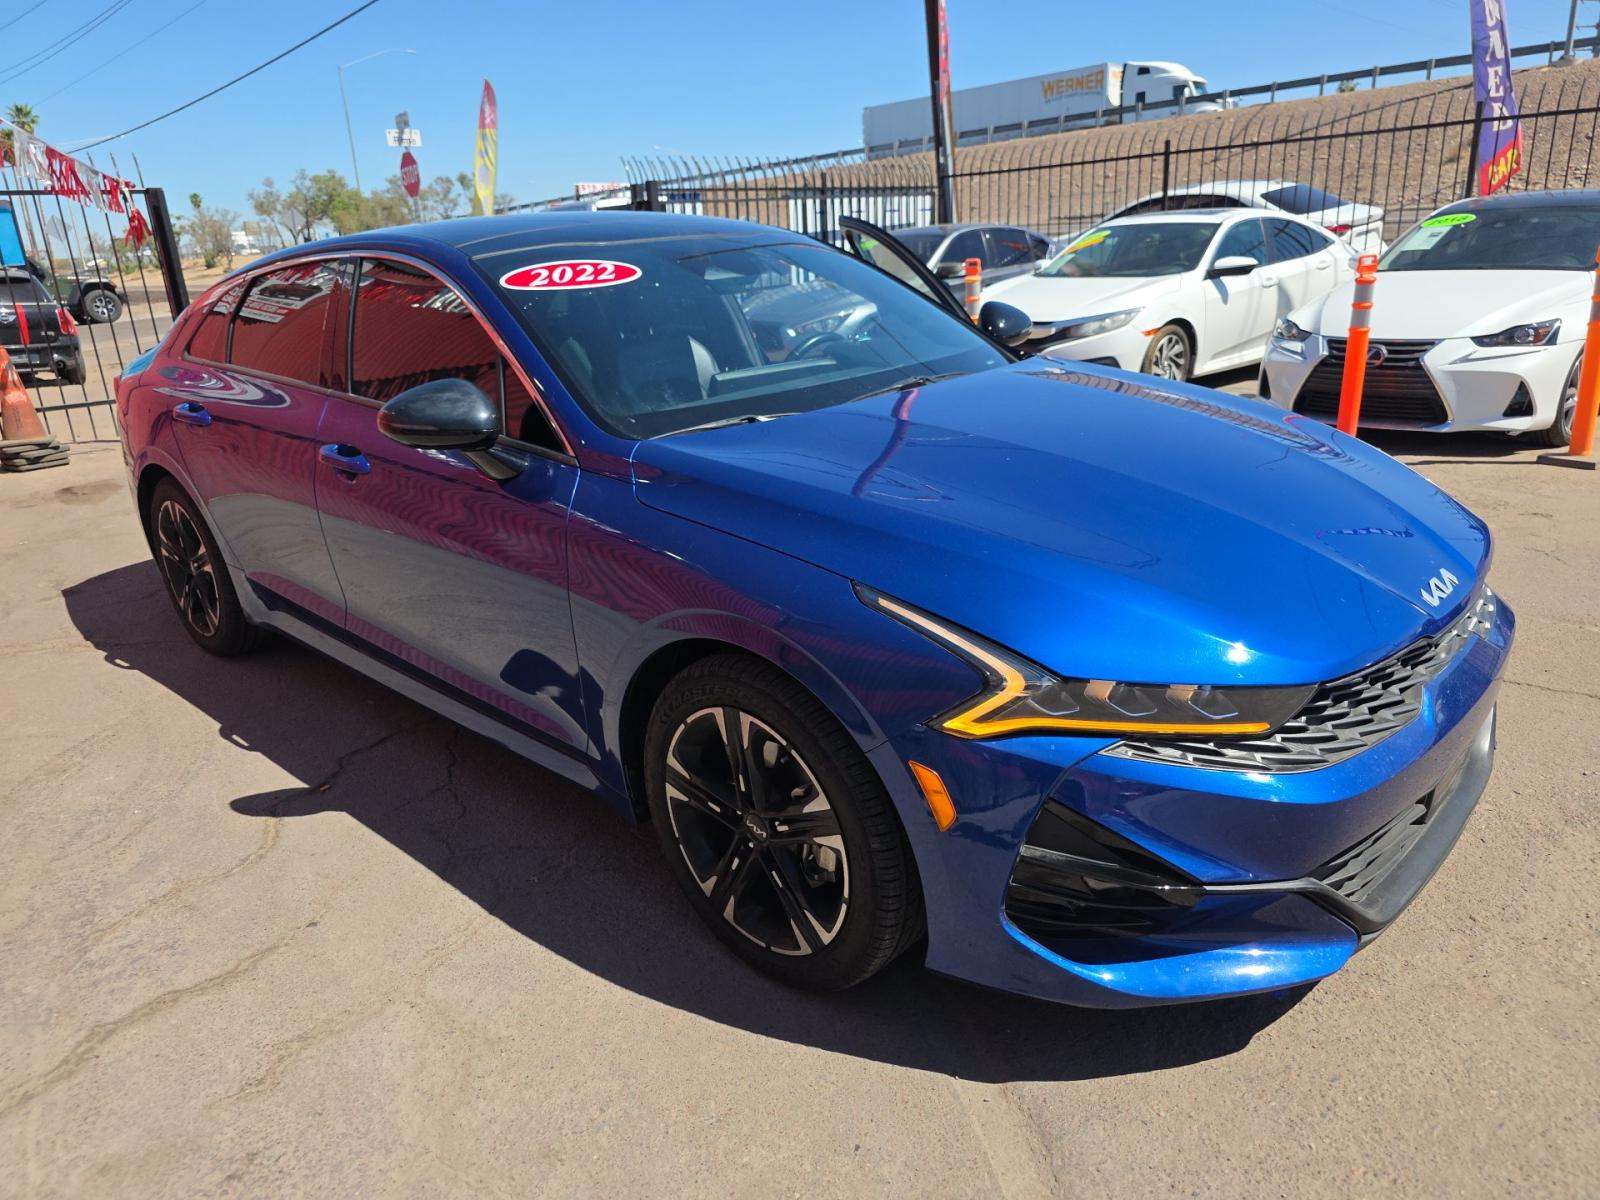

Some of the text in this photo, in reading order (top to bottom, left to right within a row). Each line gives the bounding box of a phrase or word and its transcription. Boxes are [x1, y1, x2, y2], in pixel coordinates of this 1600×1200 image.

[1041, 69, 1104, 98] WERNER
[401, 164, 419, 186] STOP
[528, 263, 616, 287] 2022
[1420, 567, 1459, 607] KIA
